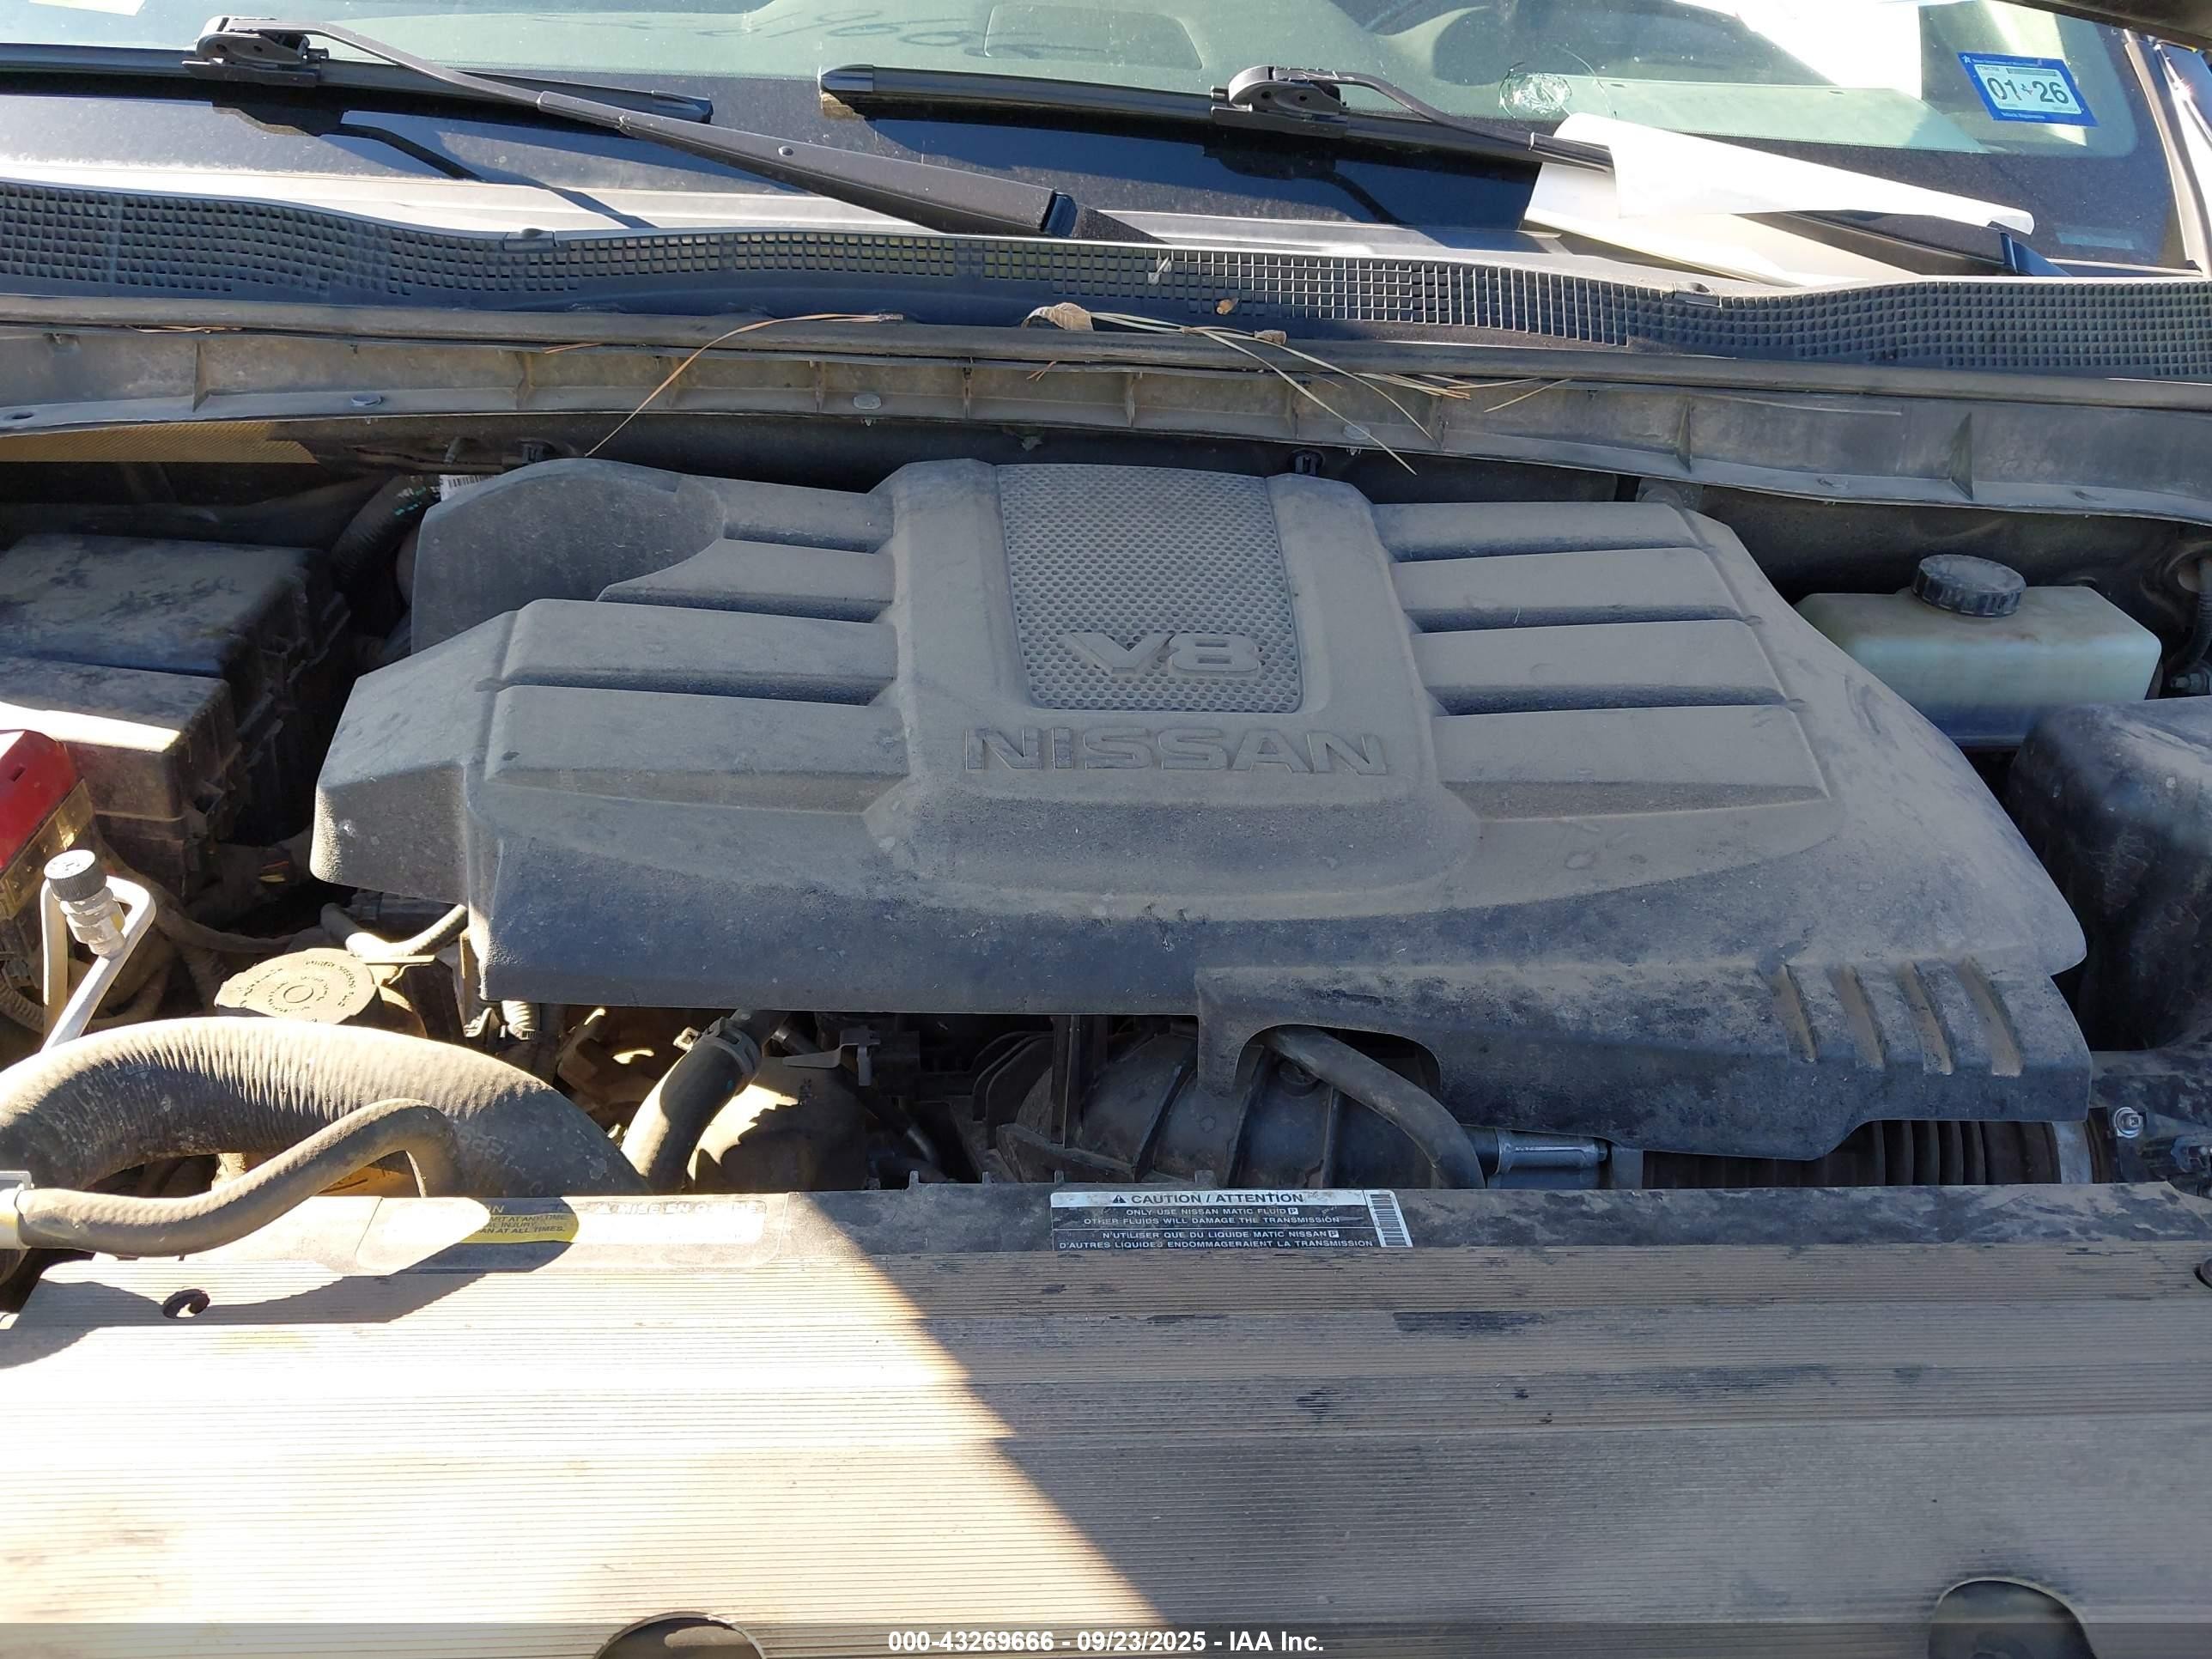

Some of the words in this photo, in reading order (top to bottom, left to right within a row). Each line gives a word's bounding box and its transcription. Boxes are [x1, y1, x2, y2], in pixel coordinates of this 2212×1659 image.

[1987, 77, 2022, 101] 01
[2032, 80, 2069, 104] 26
[1067, 631, 1260, 674] V8
[964, 726, 1388, 775] NISSAN
[1131, 1194, 1201, 1204] CAUTION
[1206, 1194, 1211, 1203] /
[1215, 1193, 1304, 1203] ATTENTION
[1294, 1239, 1374, 1249] TRANSMISSION
